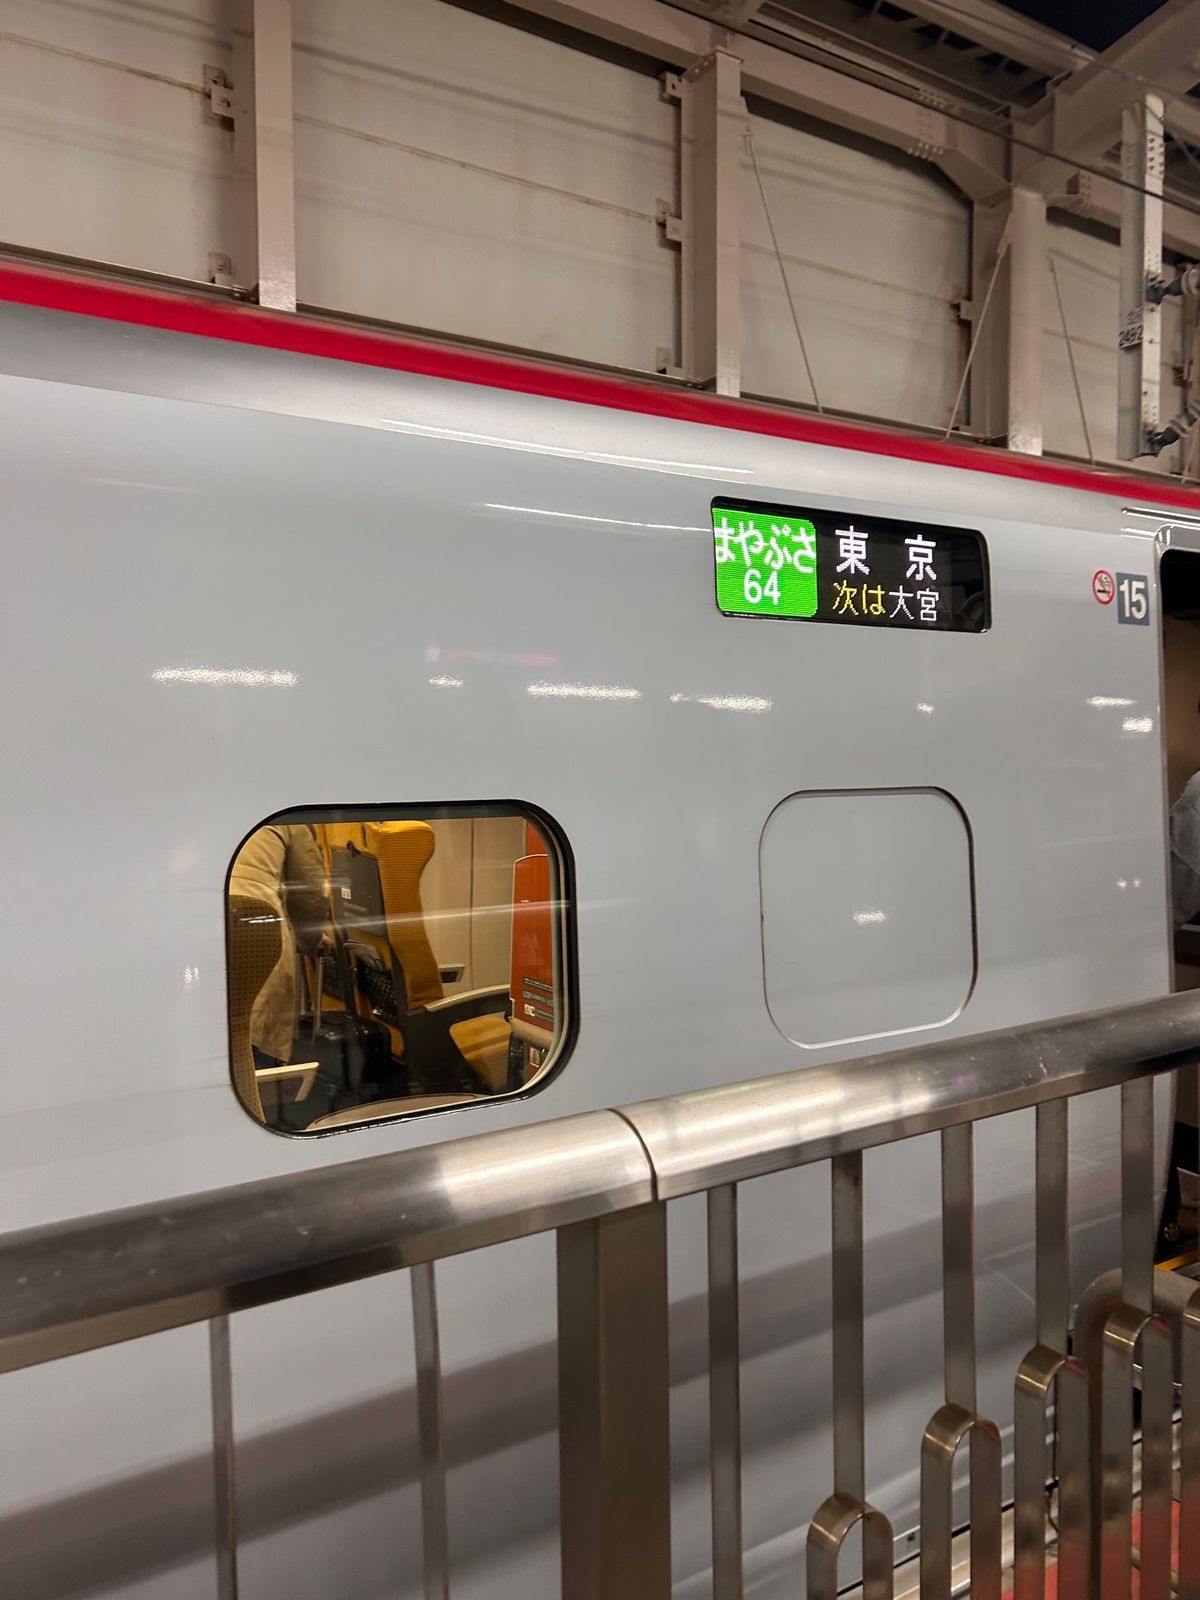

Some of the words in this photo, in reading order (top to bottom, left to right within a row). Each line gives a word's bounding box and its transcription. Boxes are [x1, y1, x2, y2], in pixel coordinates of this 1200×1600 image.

[743, 568, 782, 605] 64
[832, 579, 940, 622] 次は大宮
[1119, 579, 1147, 619] 15
